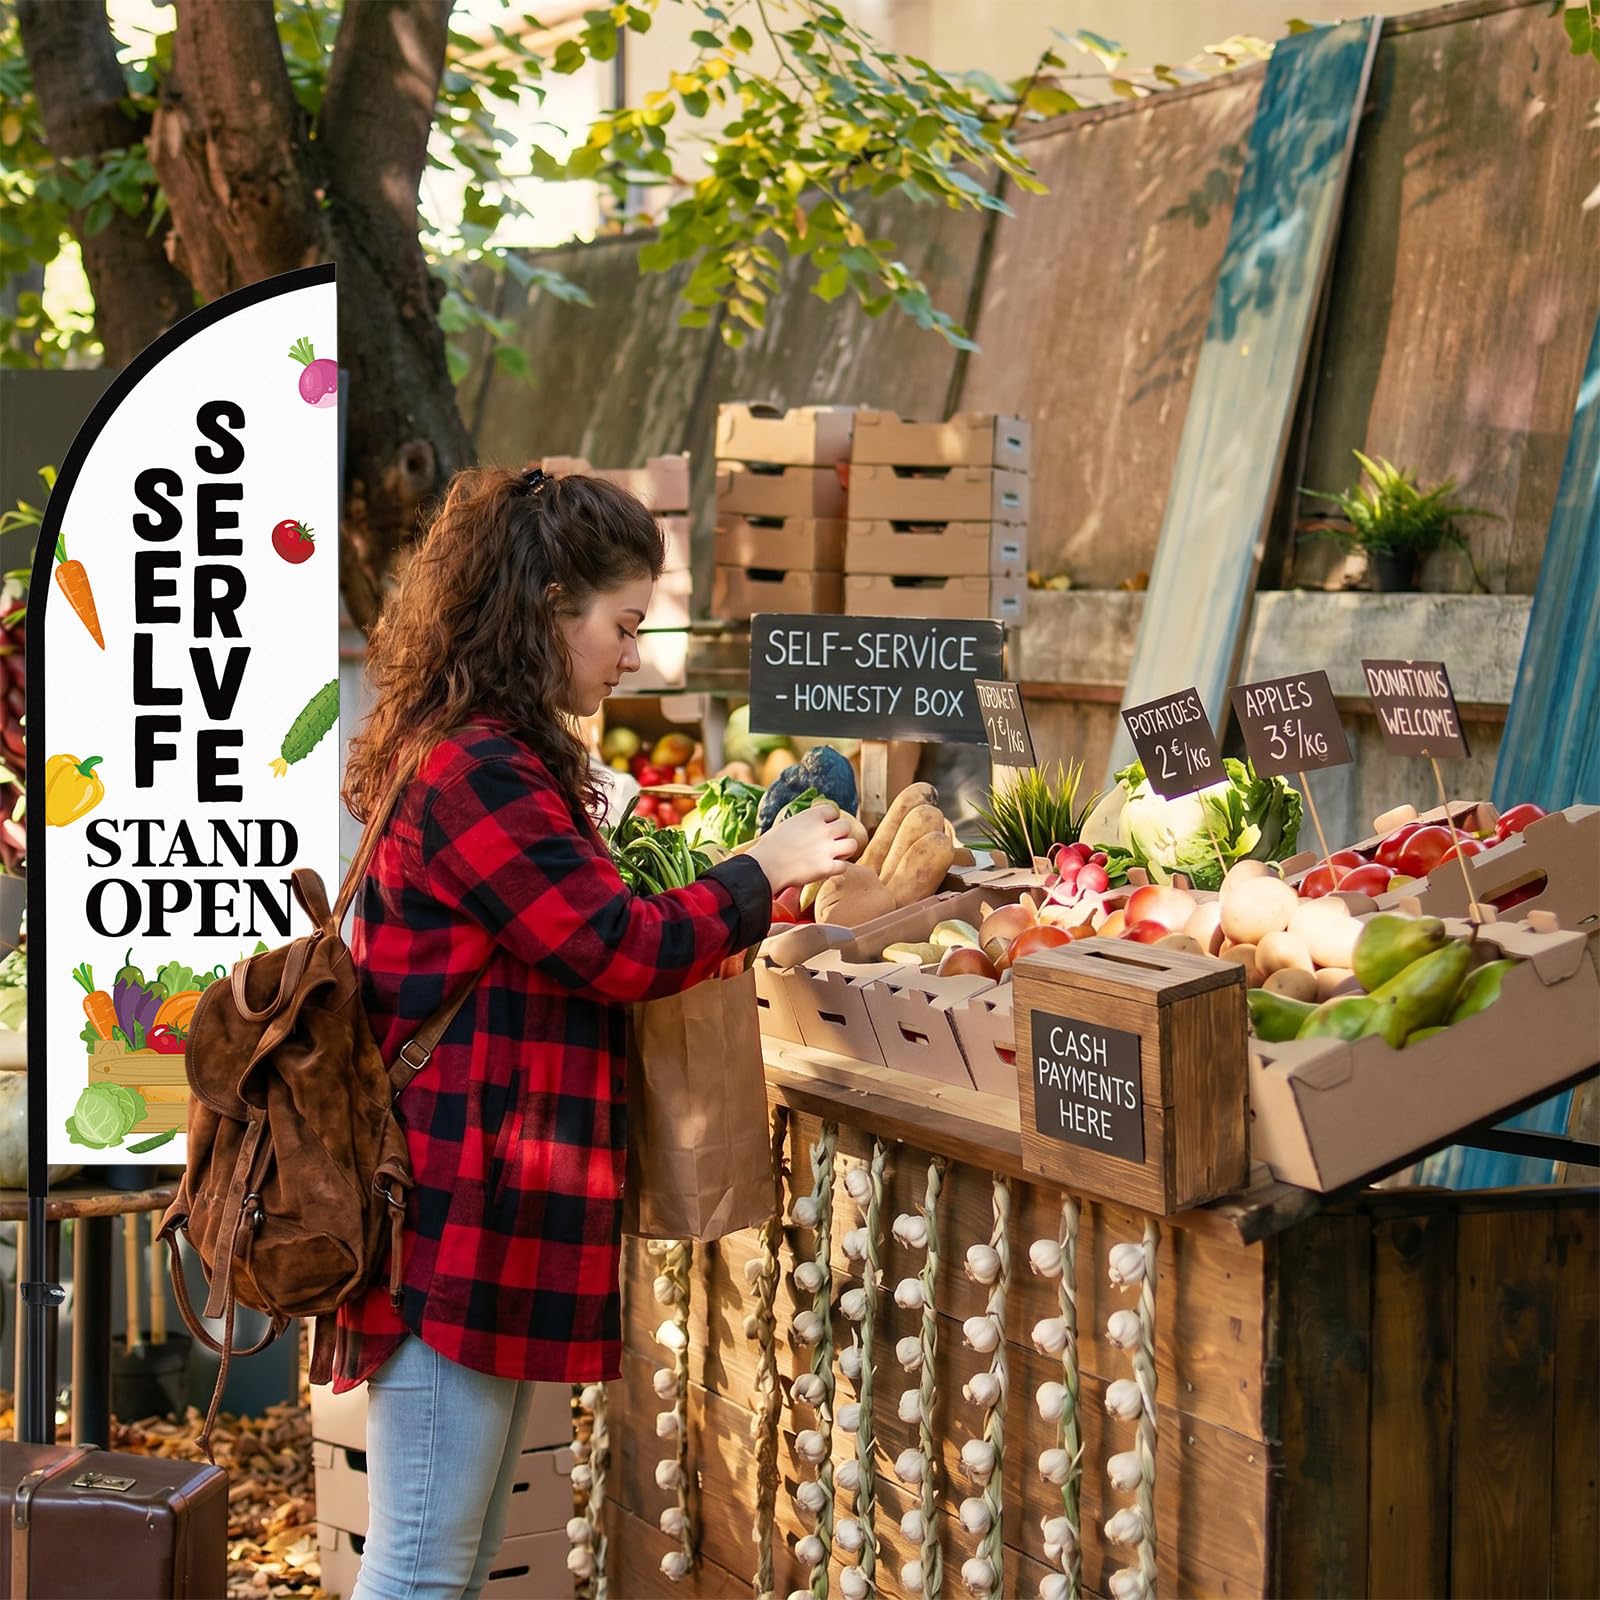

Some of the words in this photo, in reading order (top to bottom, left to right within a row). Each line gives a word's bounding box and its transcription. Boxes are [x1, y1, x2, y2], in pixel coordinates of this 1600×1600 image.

[189, 401, 251, 802] SERVE
[133, 468, 184, 788] SELF
[914, 687, 965, 718] BOX
[1246, 681, 1313, 718] APPLES
[1367, 668, 1449, 698] DONATIONS
[1128, 696, 1201, 740] POTATOES
[1263, 718, 1328, 761] 3€/KG
[1380, 707, 1459, 738] WELCOME
[1155, 738, 1212, 780] 2€/KG
[85, 818, 299, 869] STAND
[85, 878, 293, 937] OPEN
[1050, 1027, 1108, 1068] CASH
[1038, 1057, 1137, 1110] PAYMENTS
[1059, 1098, 1114, 1142] HERE
